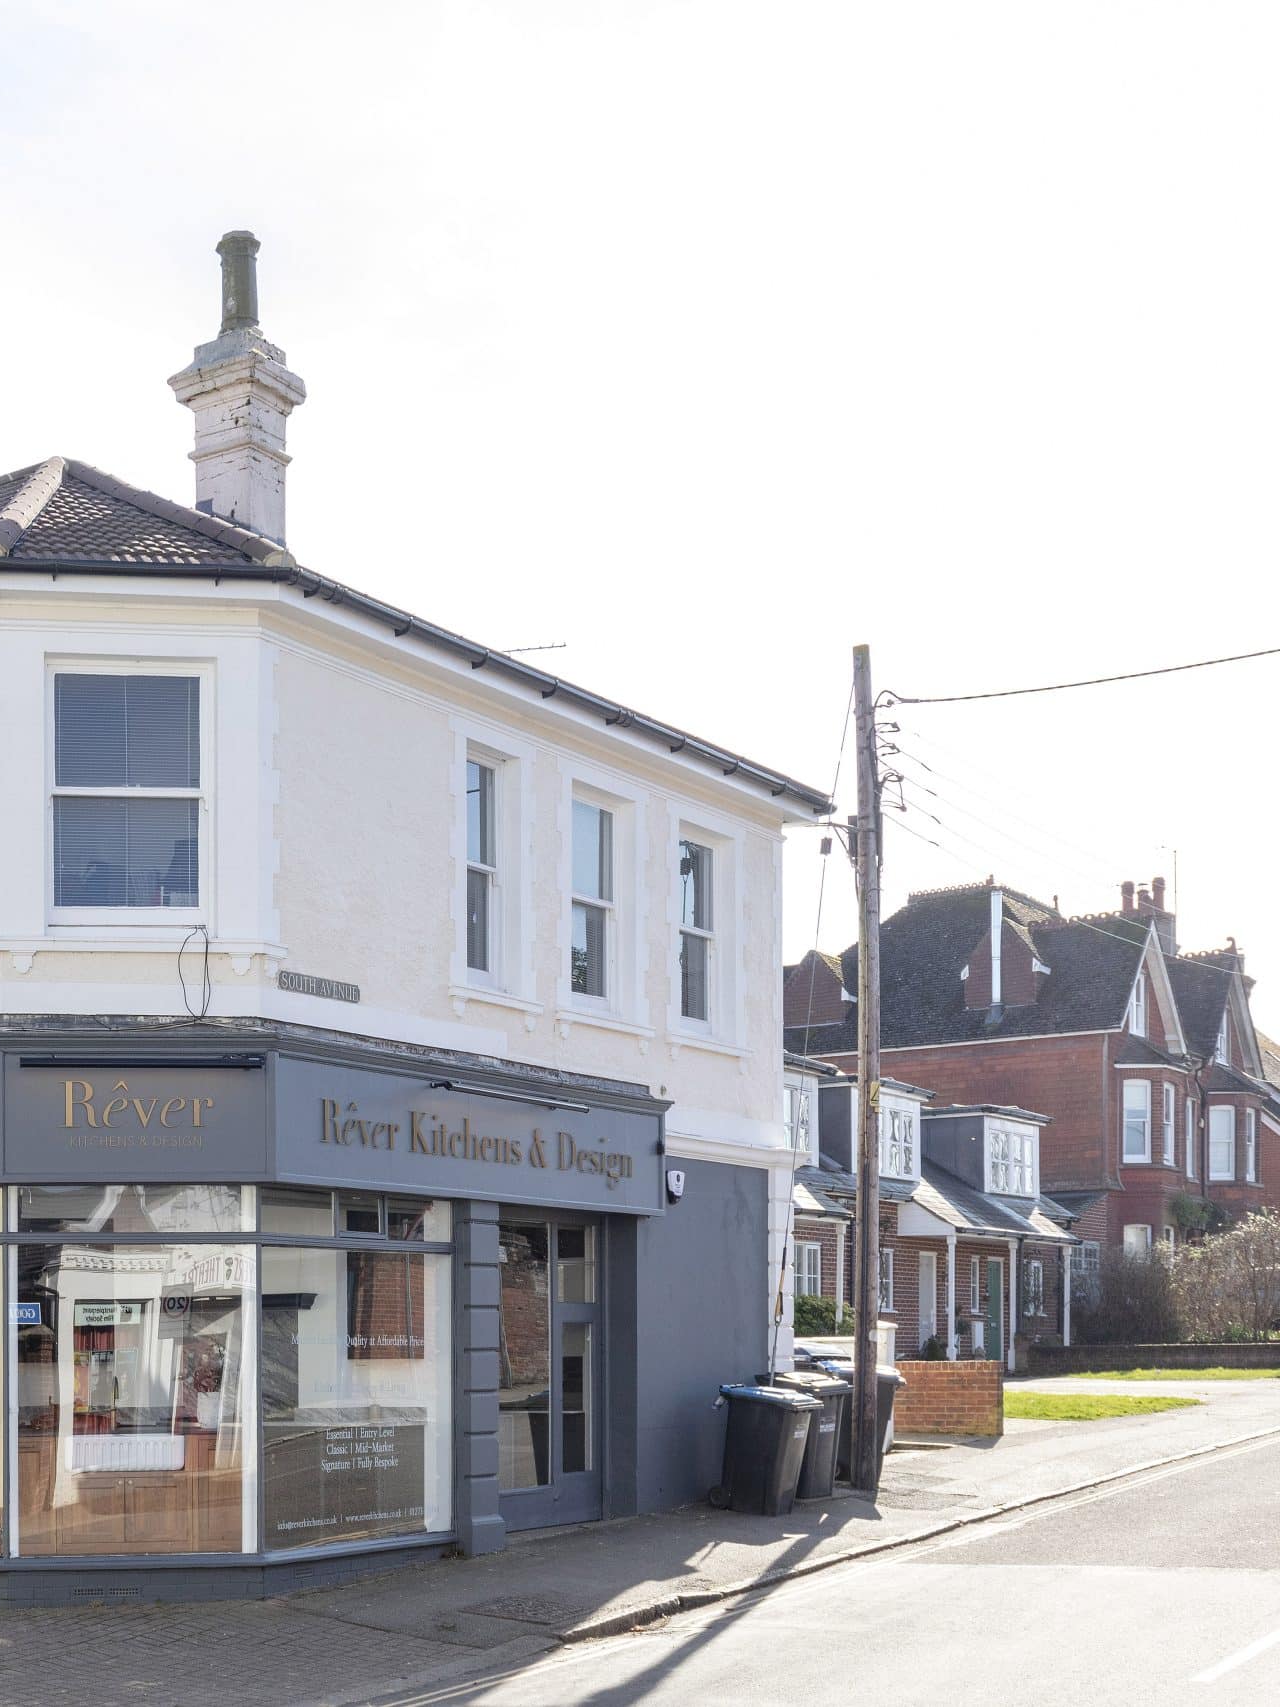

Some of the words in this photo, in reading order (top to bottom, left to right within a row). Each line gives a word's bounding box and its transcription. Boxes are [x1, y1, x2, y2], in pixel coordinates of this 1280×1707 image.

[281, 972, 317, 994] SOUTH
[320, 980, 359, 1001] AVENUE
[56, 1079, 214, 1128] Rêver
[320, 1097, 400, 1150] Rêver
[408, 1110, 521, 1166] Kitchens
[529, 1127, 548, 1169] &
[558, 1131, 634, 1190] Design
[346, 1334, 368, 1348] Quality
[376, 1334, 408, 1347] Affordable
[326, 1426, 353, 1440] Essential
[360, 1427, 378, 1440] Entry
[326, 1442, 348, 1455] Classic
[355, 1440, 394, 1454] Mid-Market
[321, 1460, 351, 1473] Signature
[357, 1457, 373, 1470] Fully
[374, 1456, 398, 1470] Bespoke
